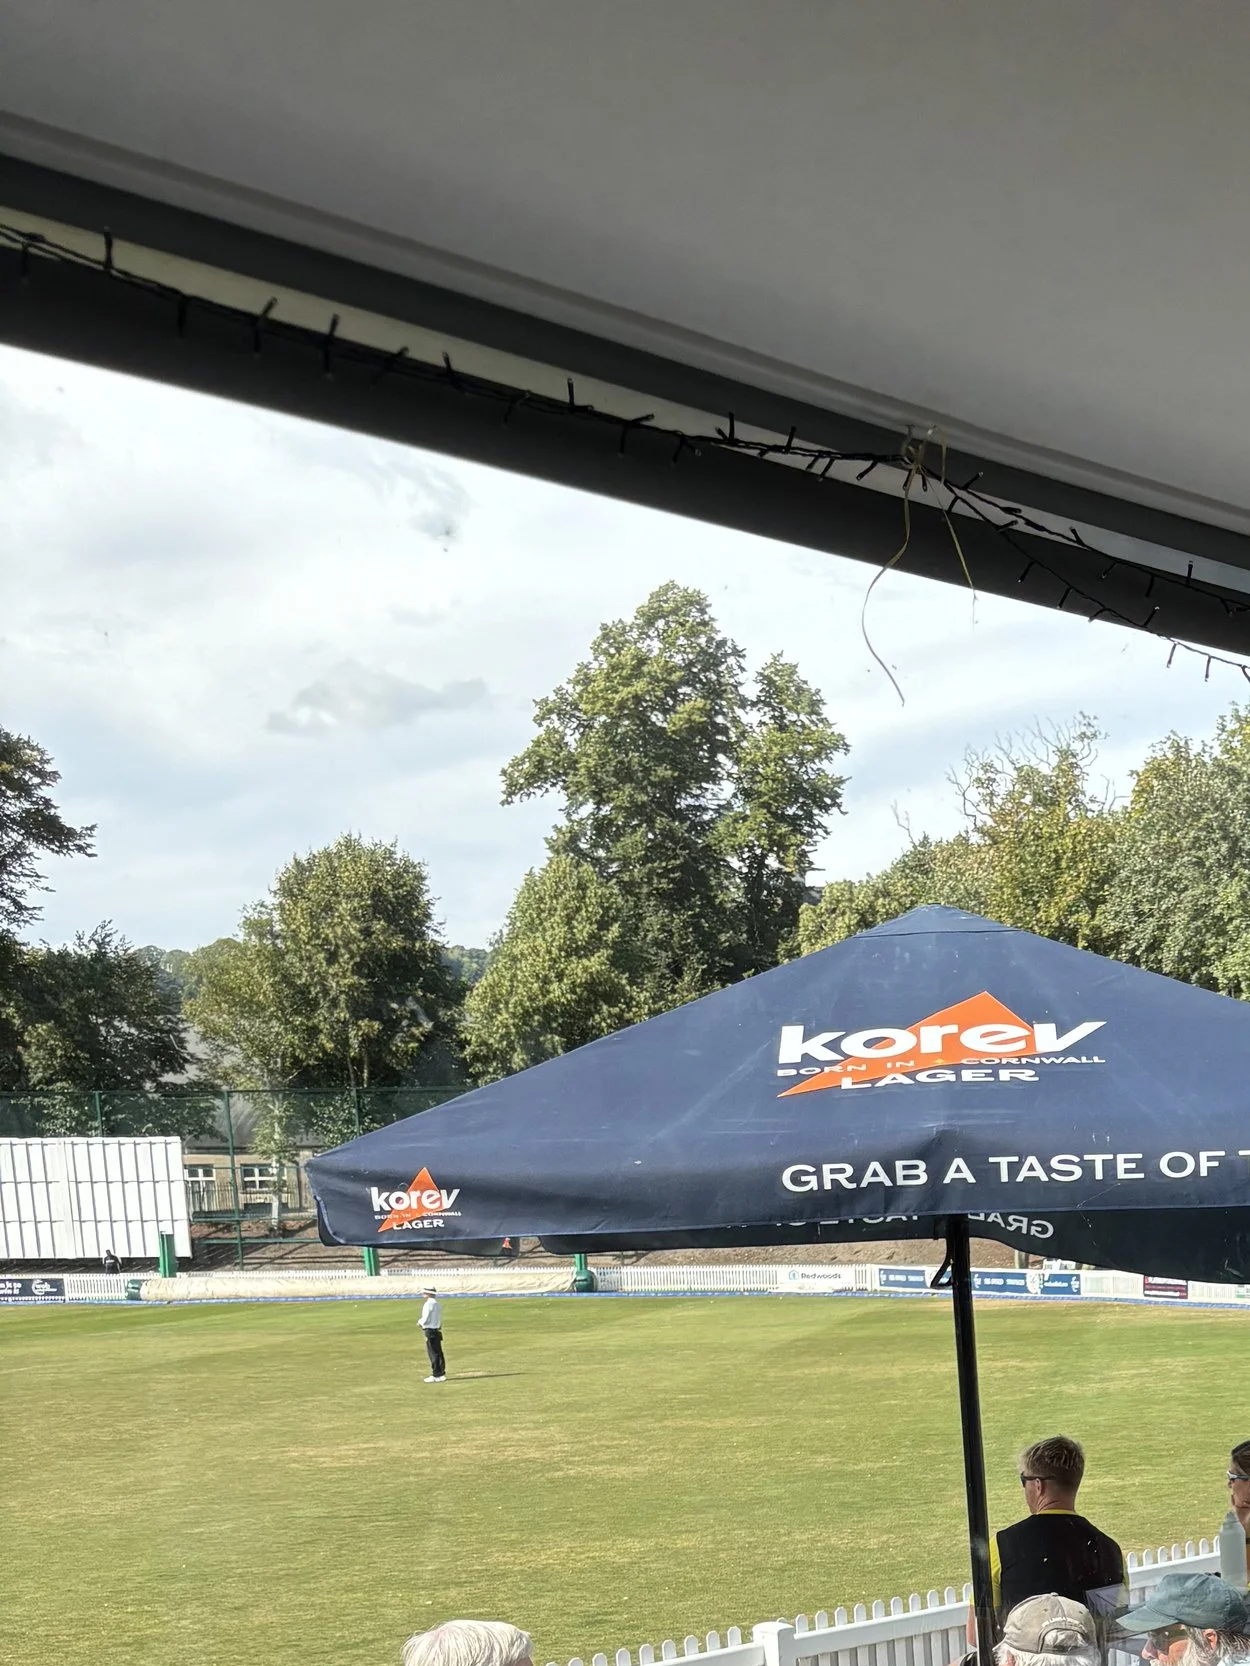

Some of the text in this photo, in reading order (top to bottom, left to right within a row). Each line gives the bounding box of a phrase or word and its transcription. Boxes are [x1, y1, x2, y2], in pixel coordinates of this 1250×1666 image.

[779, 1021, 1107, 1064] korev
[776, 1056, 1106, 1077] BORN IN CORNWALL
[840, 1068, 1039, 1090] LAGER
[782, 1159, 928, 1192] GRAB
[942, 1157, 976, 1184] A
[989, 1153, 1145, 1183] TASTE
[1159, 1150, 1226, 1179] OF
[370, 1186, 460, 1212] korev
[393, 1218, 445, 1231] LAGER
[800, 1272, 842, 1280] Redwoods
